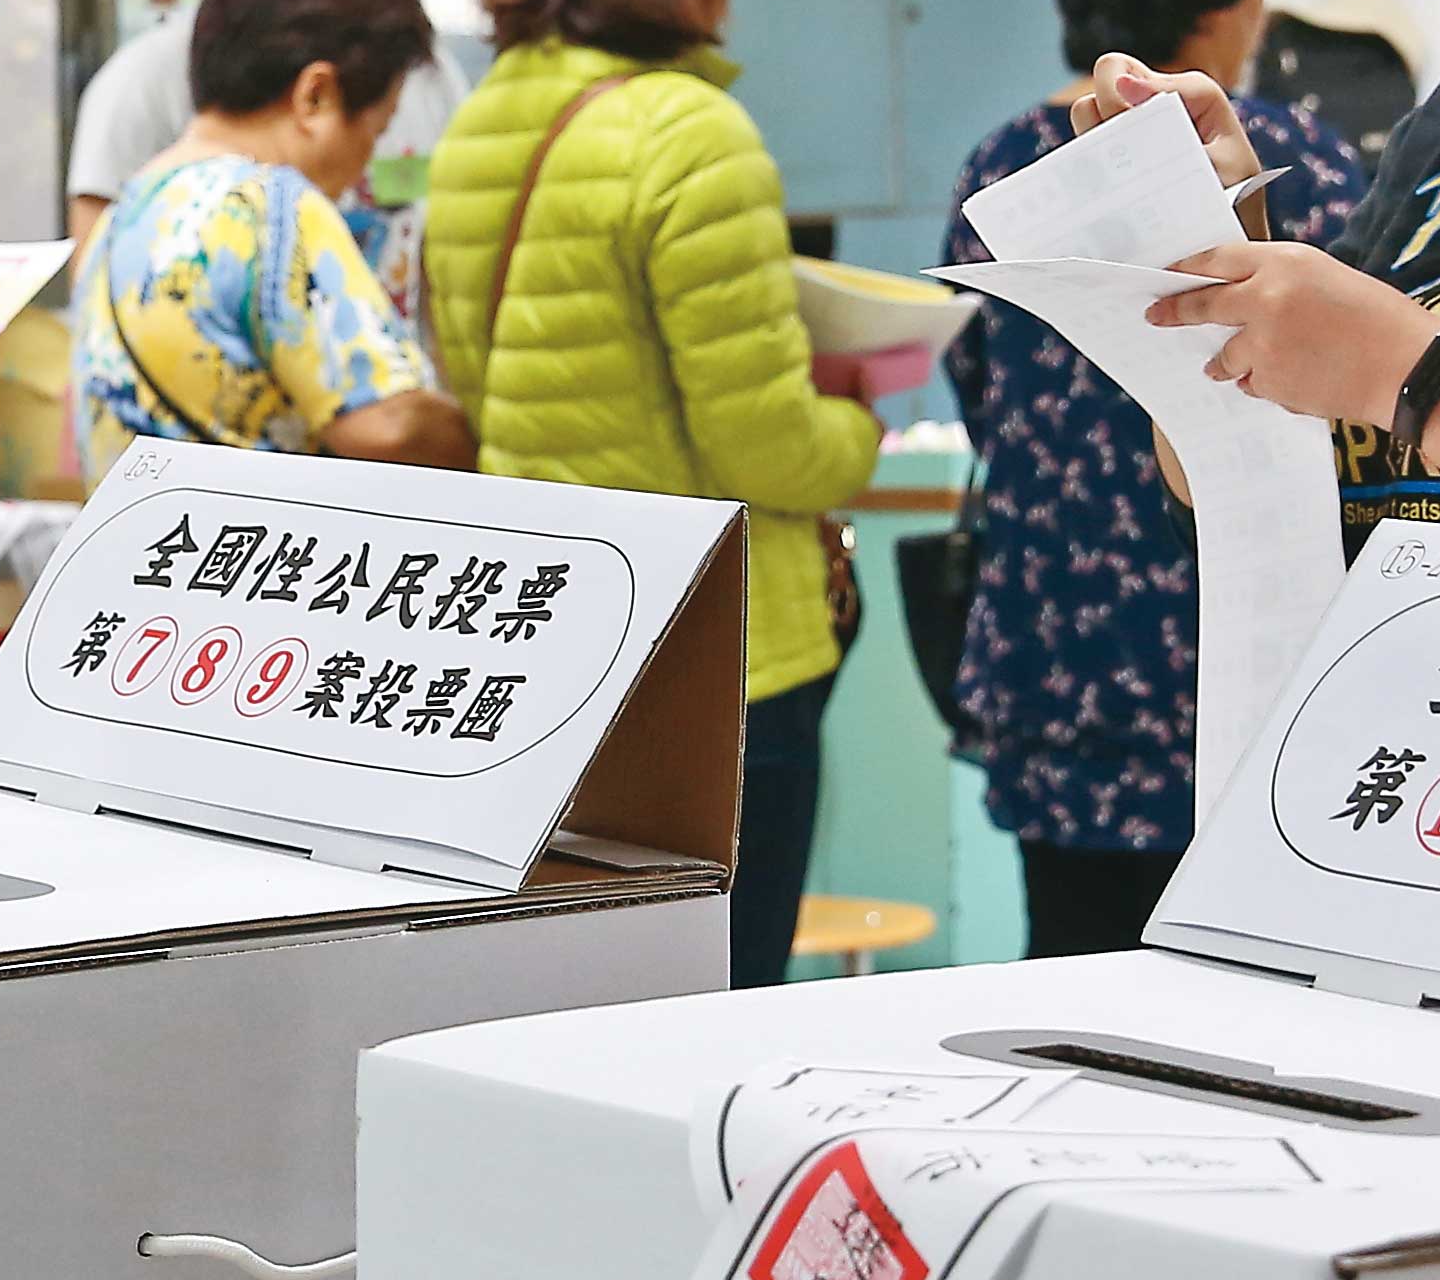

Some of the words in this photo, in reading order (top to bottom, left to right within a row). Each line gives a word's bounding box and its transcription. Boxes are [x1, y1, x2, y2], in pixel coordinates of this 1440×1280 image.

[133, 513, 570, 644] 全國性公民投票
